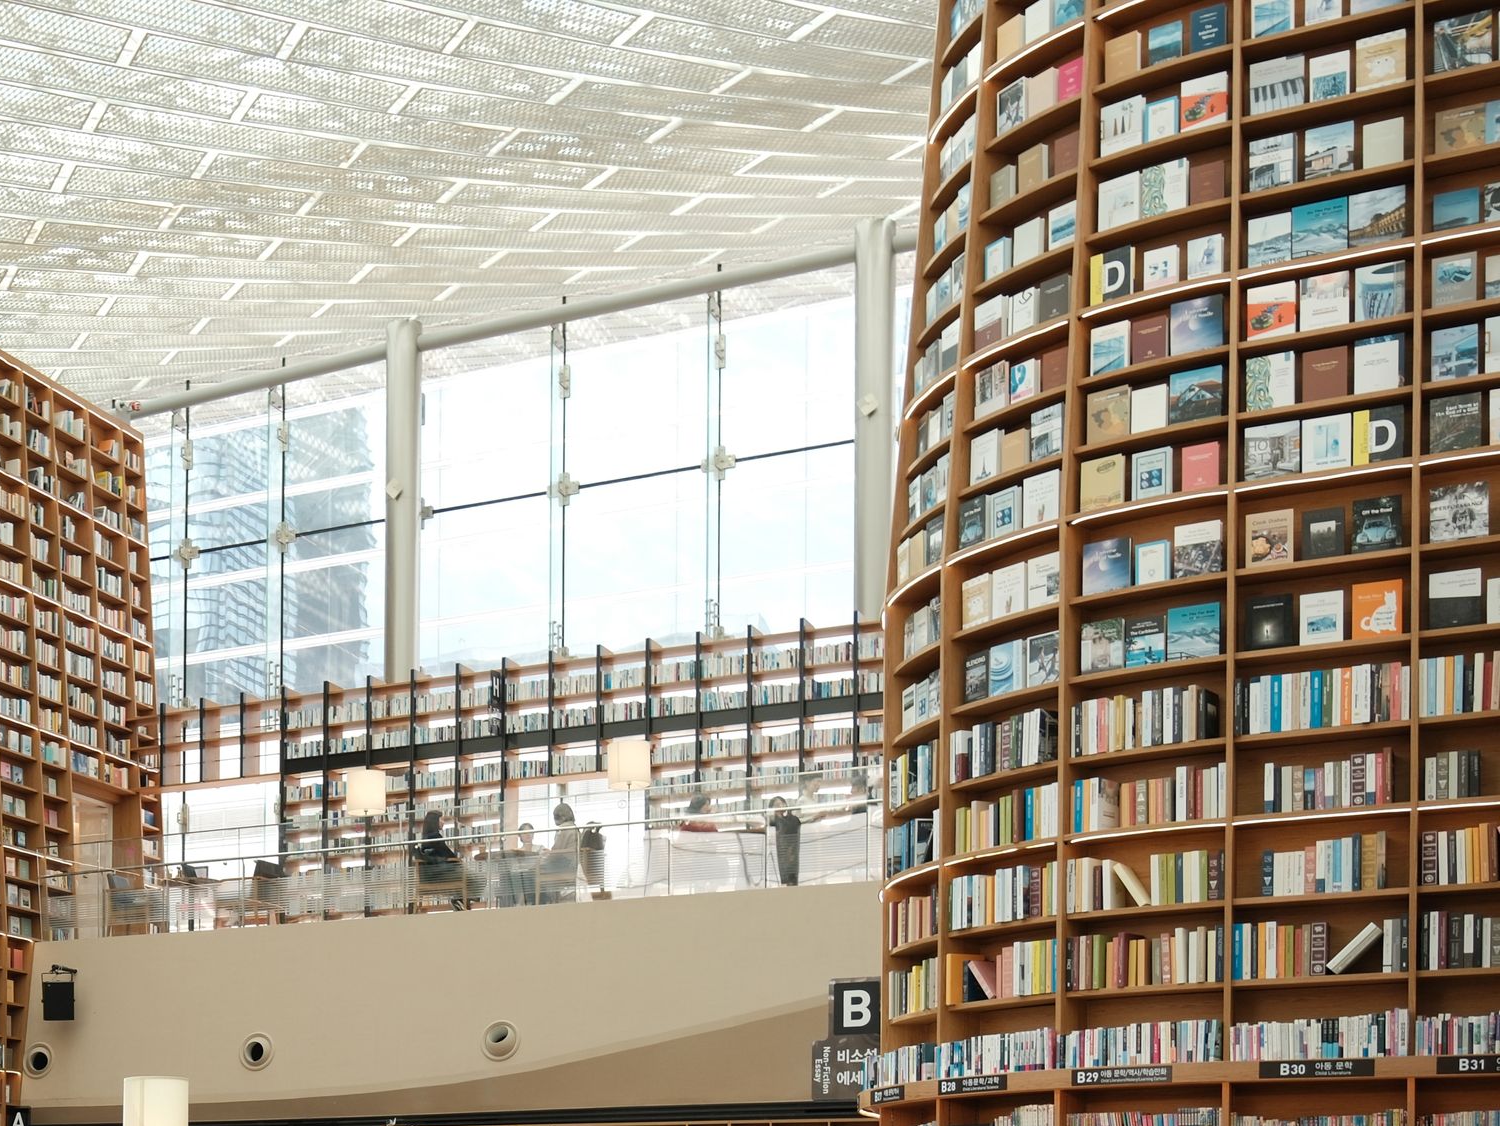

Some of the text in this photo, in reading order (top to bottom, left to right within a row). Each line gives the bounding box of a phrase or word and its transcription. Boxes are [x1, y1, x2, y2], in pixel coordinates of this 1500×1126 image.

[842, 989, 872, 1028] B
[813, 1058, 823, 1083] Essay
[822, 1046, 831, 1095] Non-Fiction
[1279, 1063, 1306, 1076] B30
[1458, 1058, 1485, 1072] B31
[1077, 1071, 1099, 1084] B29
[941, 1081, 956, 1093] B28
